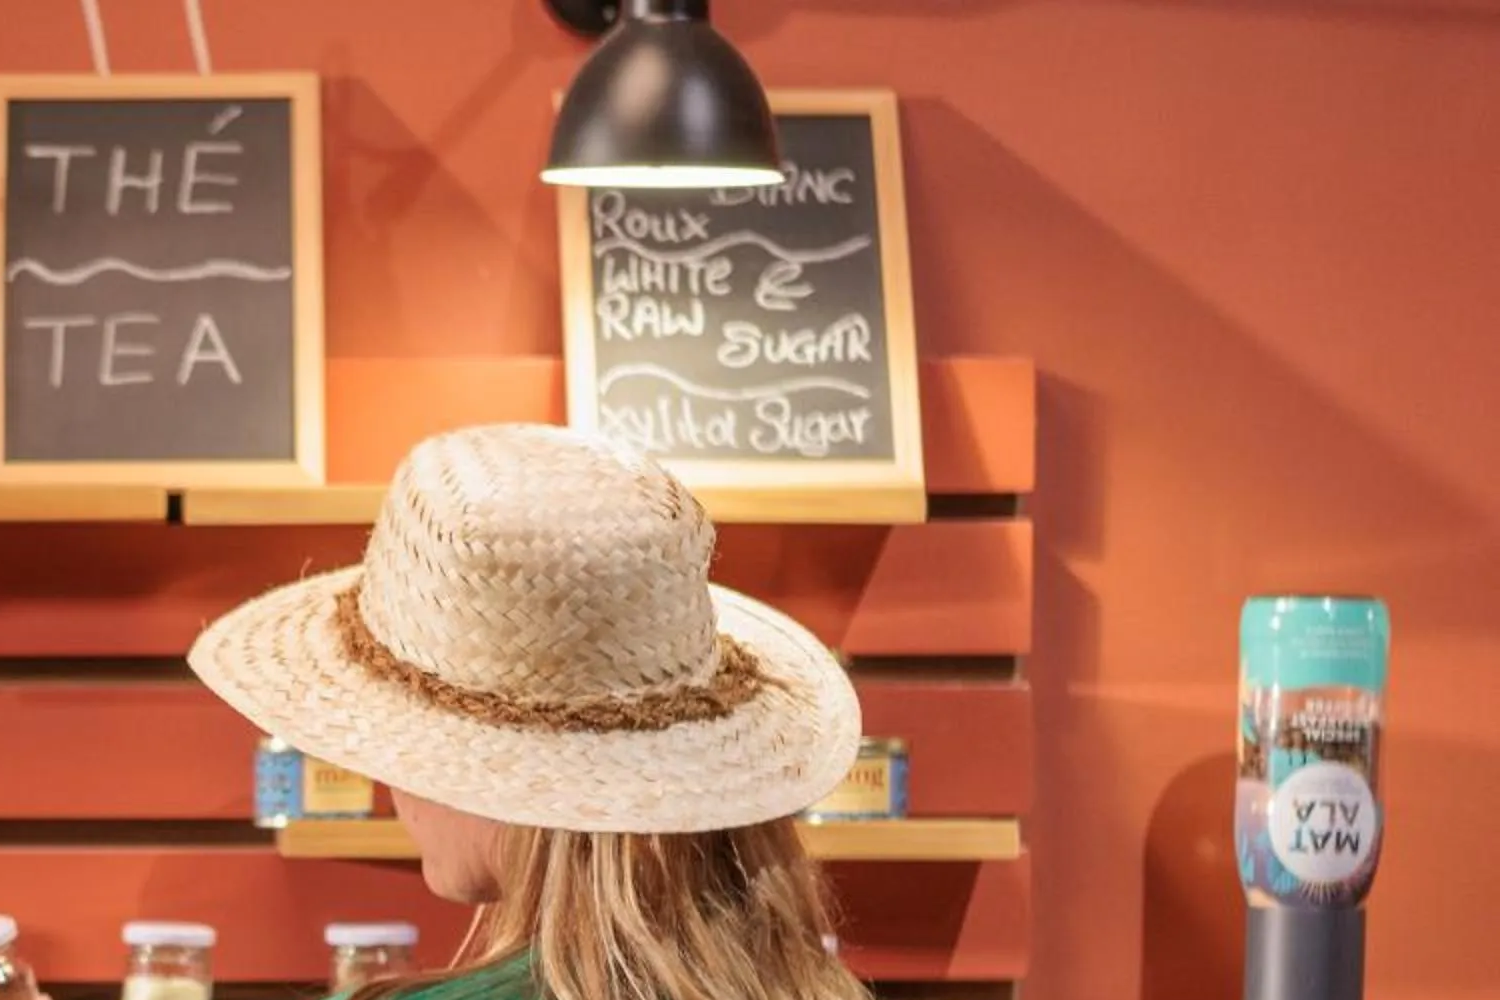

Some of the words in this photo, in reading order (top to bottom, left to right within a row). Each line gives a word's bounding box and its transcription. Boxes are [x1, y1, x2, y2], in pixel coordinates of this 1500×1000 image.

[24, 104, 244, 216] THÉ
[593, 189, 712, 242] Roux
[22, 311, 243, 389] TEA
[597, 296, 706, 341] RAW
[717, 312, 872, 368] SUGAR
[749, 396, 873, 458] Sugar
[1291, 828, 1360, 856] MAT
[1293, 801, 1361, 827] ALA
